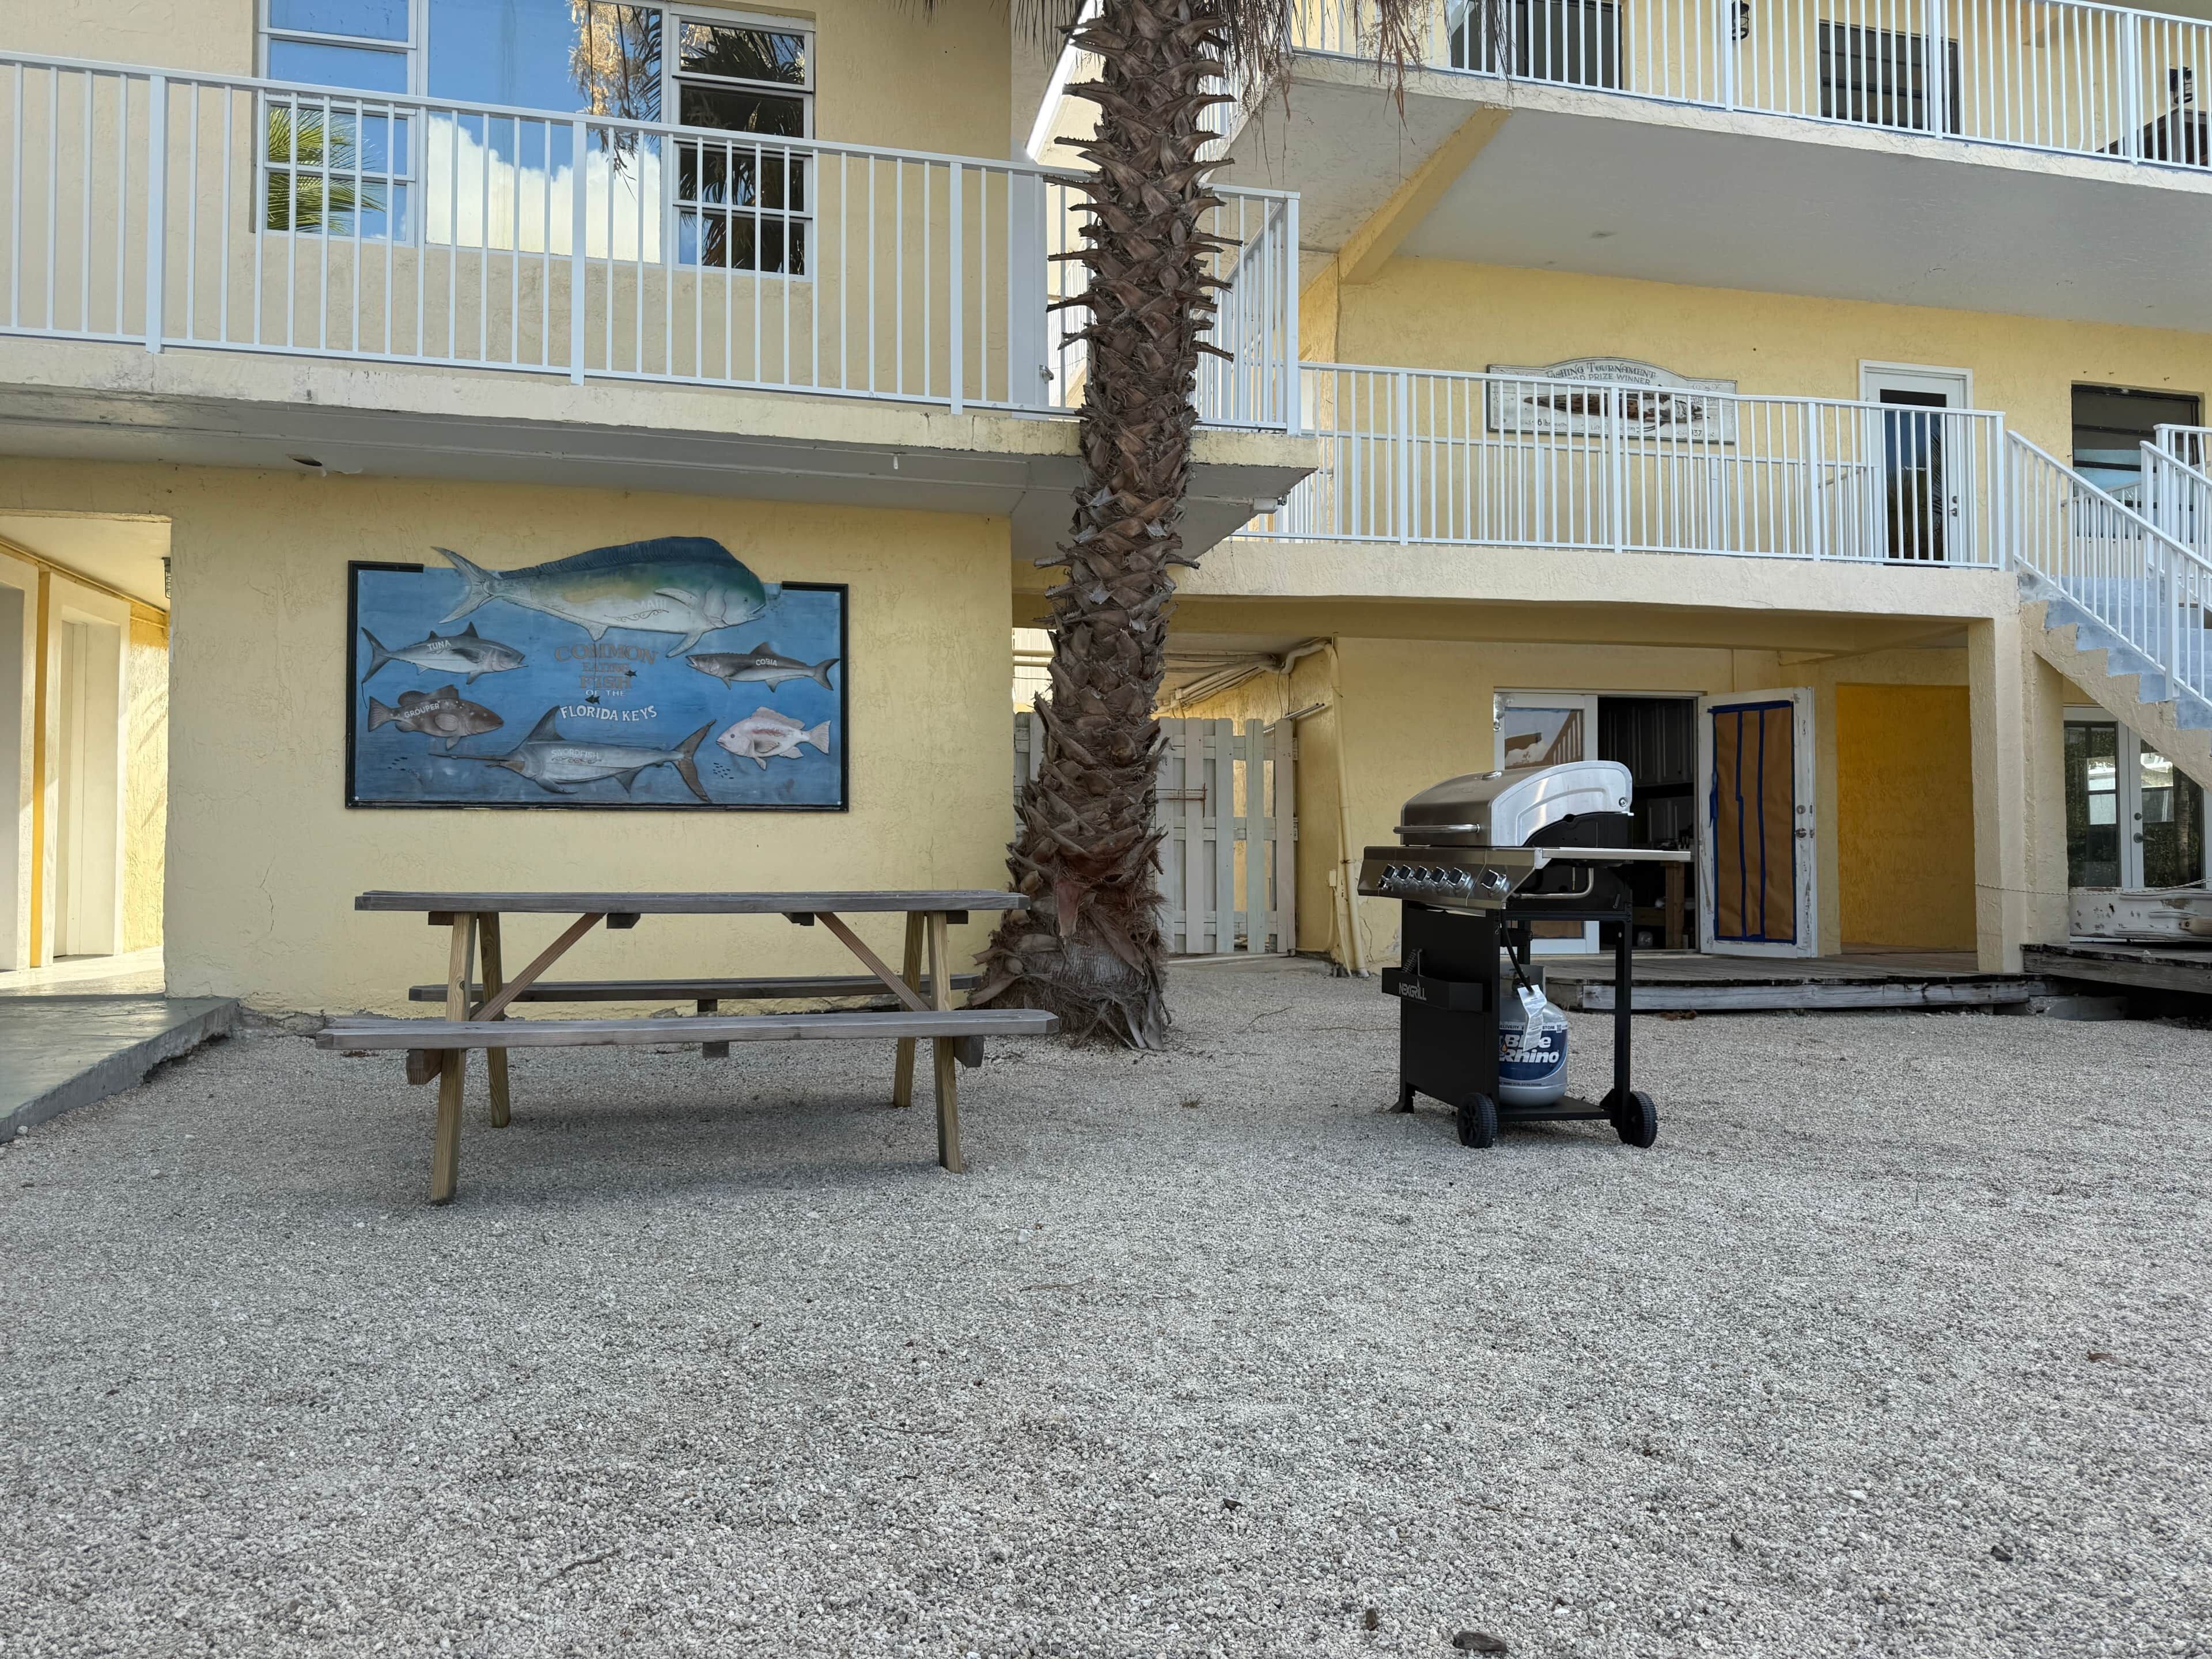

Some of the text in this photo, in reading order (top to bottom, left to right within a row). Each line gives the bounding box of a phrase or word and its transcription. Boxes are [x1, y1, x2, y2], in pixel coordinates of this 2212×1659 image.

[1616, 373, 1650, 385] WINNER
[427, 639, 452, 651] TUNA
[554, 643, 659, 665] COMMON
[755, 658, 778, 666] COBIA
[579, 675, 632, 689] FISH
[404, 703, 440, 718] GROUPER
[560, 705, 657, 721] FLORIDA KEYS
[551, 748, 599, 760] SWORDFISH
[1399, 982, 1427, 1001] NEXGRILL
[1505, 1034, 1552, 1048] Ble
[1500, 1049, 1560, 1063] Rhino
